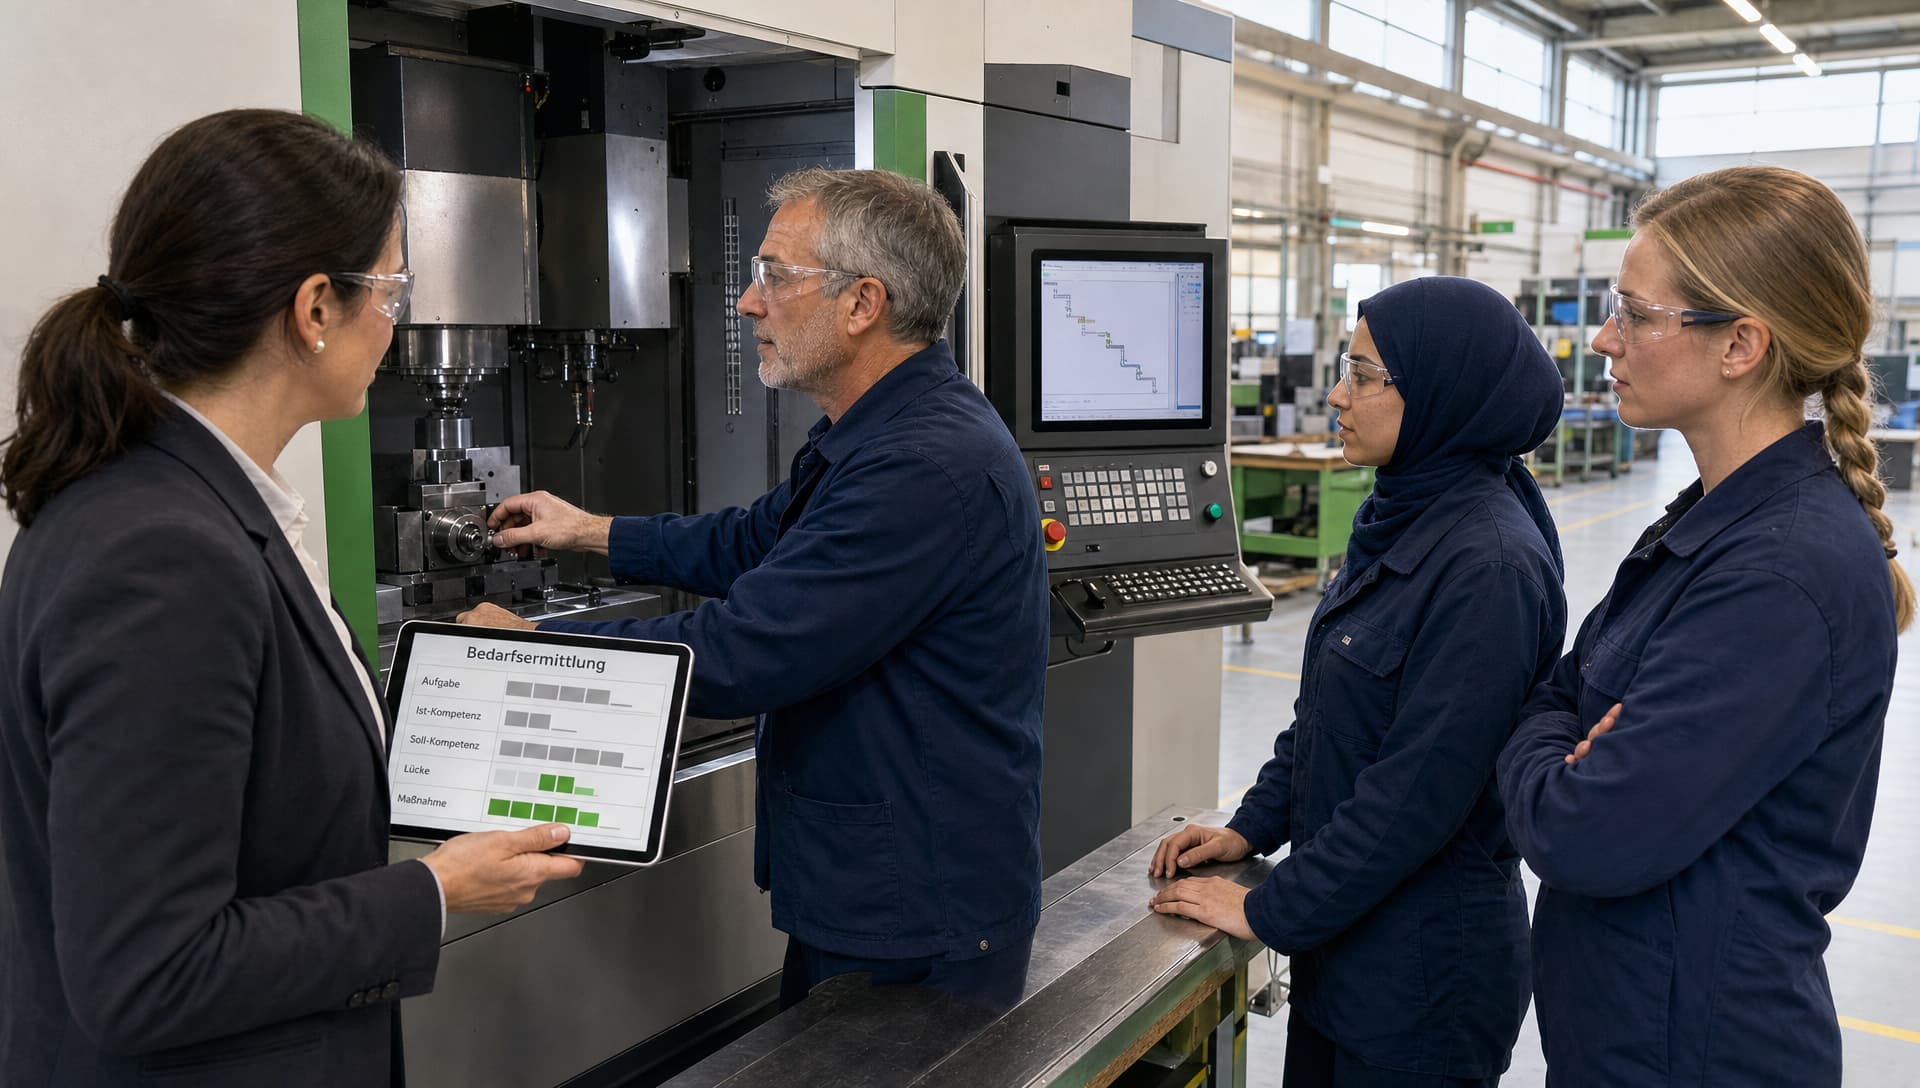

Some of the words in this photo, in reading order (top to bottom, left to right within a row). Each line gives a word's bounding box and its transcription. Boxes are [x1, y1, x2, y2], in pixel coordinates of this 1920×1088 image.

[466, 646, 606, 673] Bedarfsermittlung
[421, 676, 461, 691] Aufgabe
[416, 706, 482, 721] Ist-Kompetenz
[409, 735, 480, 750] Soll-Kompetenz
[403, 764, 431, 775] Lücke
[397, 794, 447, 808] Maßnahme
